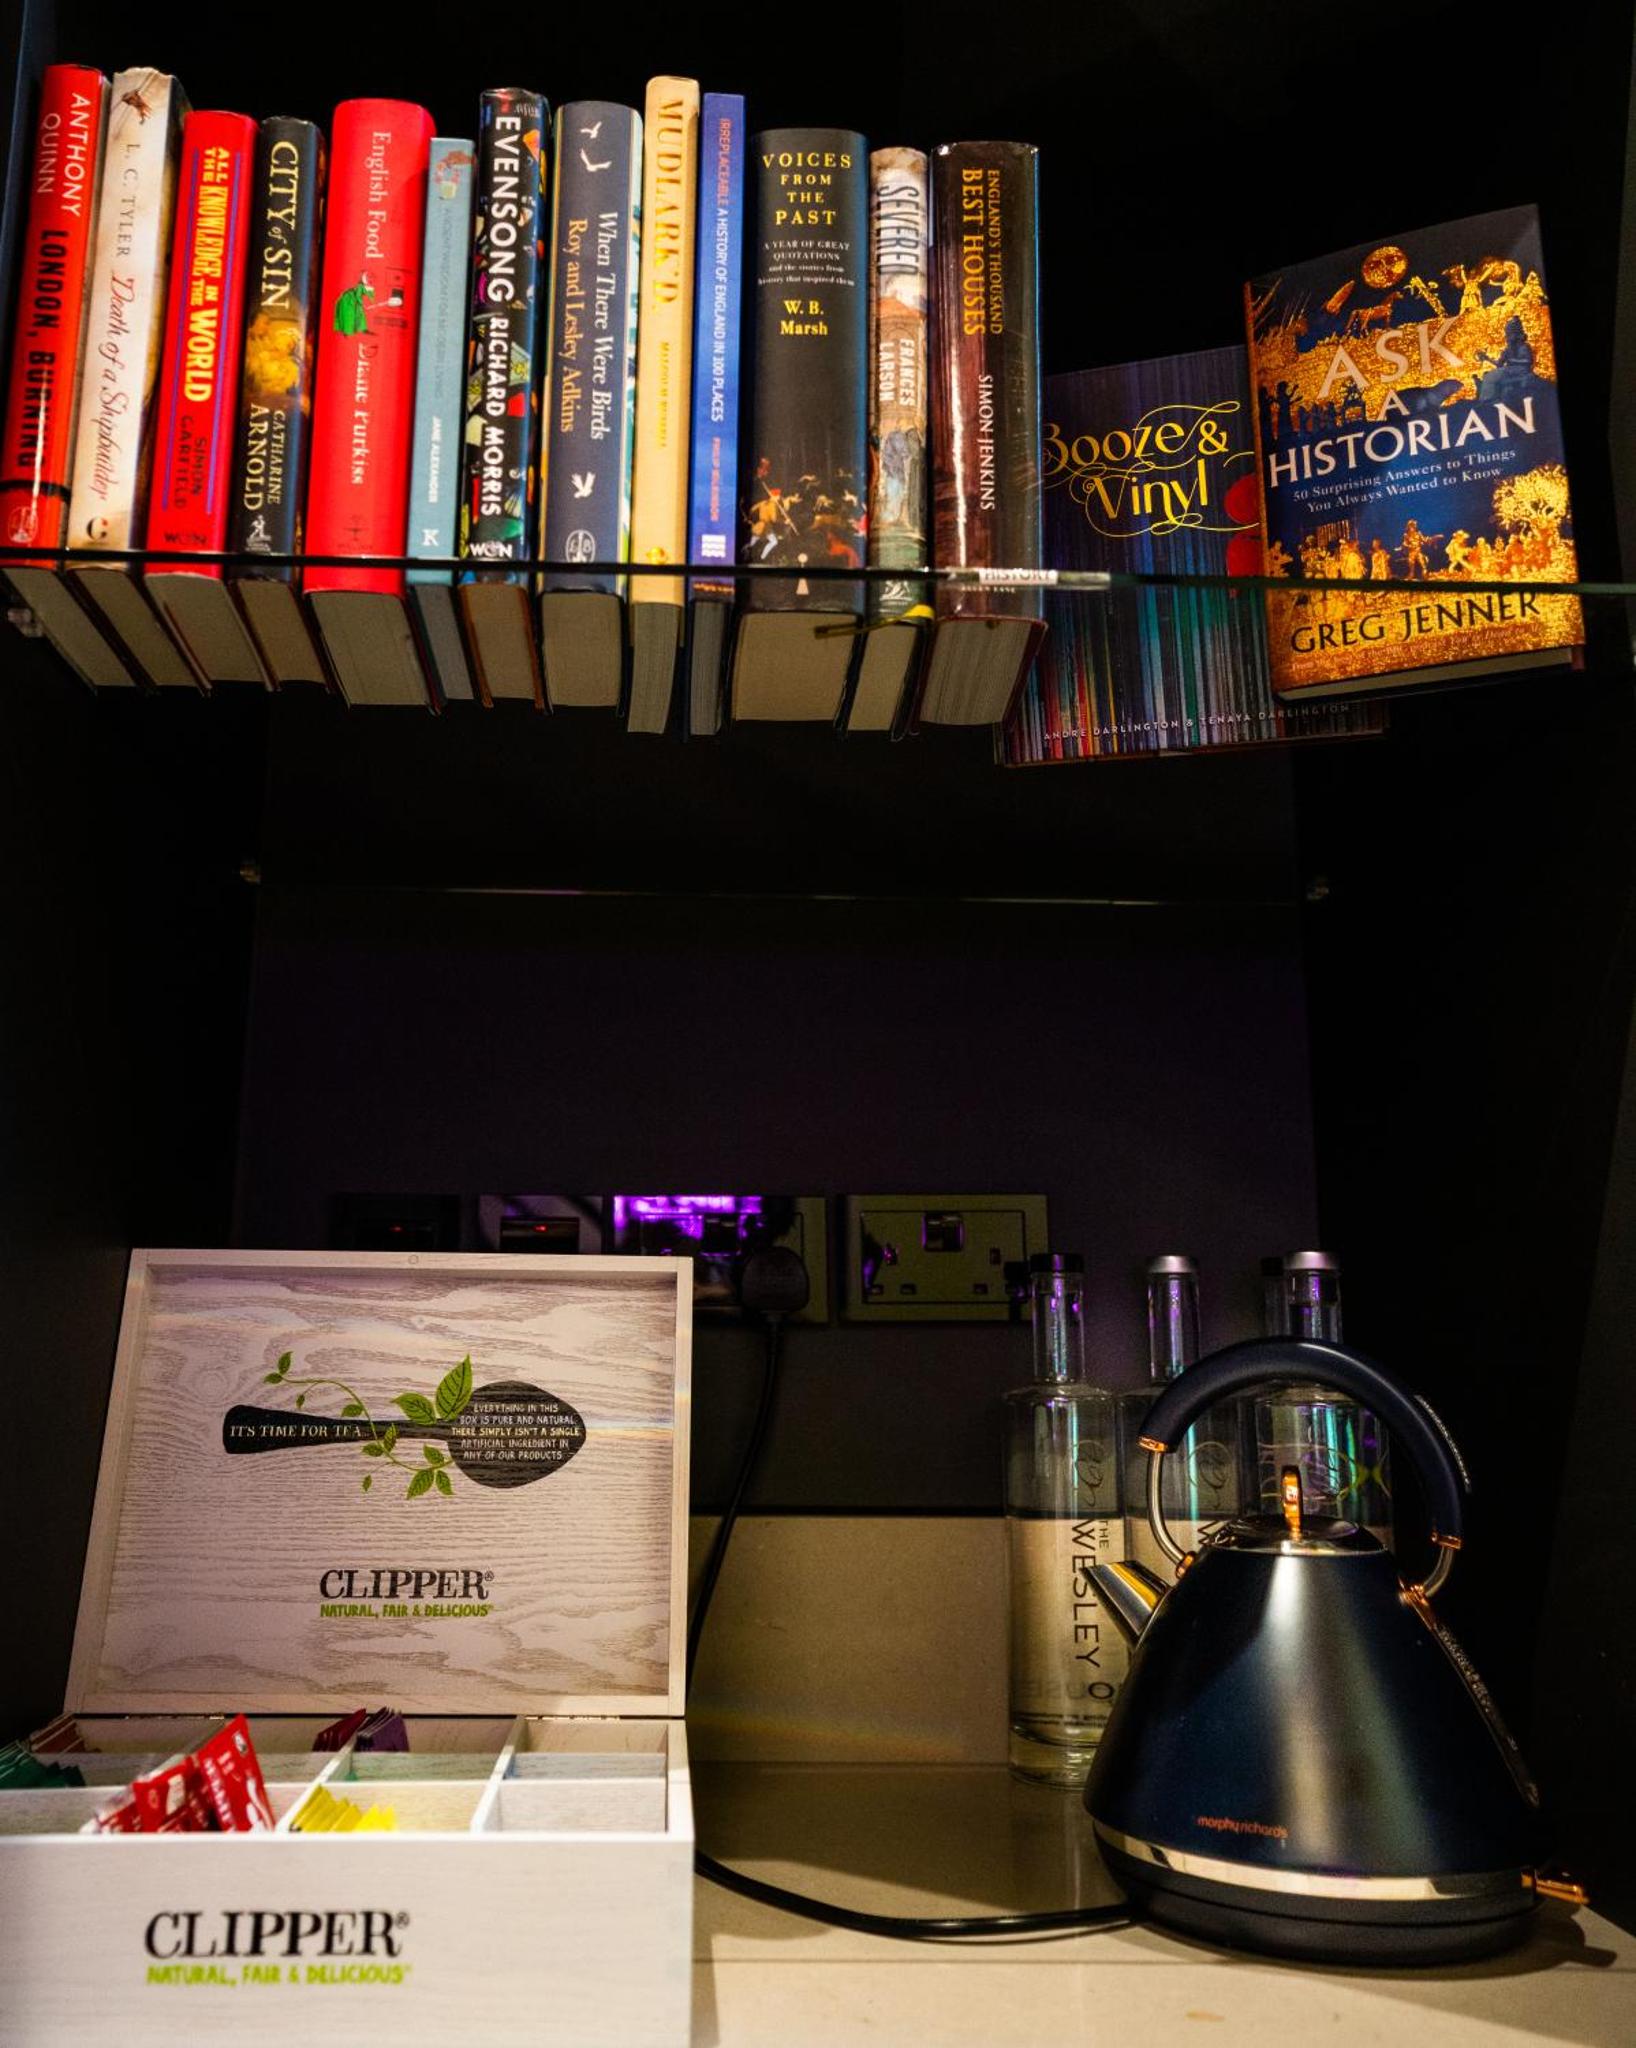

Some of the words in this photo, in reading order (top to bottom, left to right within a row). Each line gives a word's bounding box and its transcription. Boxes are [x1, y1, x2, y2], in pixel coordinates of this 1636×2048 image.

[37, 113, 61, 193] QUINN
[61, 92, 91, 217] ANTHONY
[122, 168, 139, 187] C.
[124, 143, 141, 159] L.
[203, 146, 217, 183] THE
[217, 147, 230, 183] ALL
[365, 132, 391, 202] English
[718, 118, 731, 206] IRREPLACEABLE
[762, 152, 852, 169] VOICES
[267, 141, 299, 231] CITY
[780, 174, 832, 185] FROM
[787, 192, 824, 203] THE
[962, 168, 984, 223] BEST
[116, 196, 136, 257] TYLER
[192, 185, 228, 278] KNOWLEDGE
[268, 226, 287, 244] of
[365, 210, 387, 259] Food
[487, 116, 521, 302] EVENSONG
[718, 208, 729, 219] A
[775, 210, 836, 225] PAST
[876, 185, 919, 275] SEVERED
[987, 170, 1000, 250] ENGLAND'S
[563, 219, 588, 255] Roy
[597, 212, 618, 266] When
[715, 220, 729, 264] HISTORY
[772, 240, 798, 249] YEAR
[801, 240, 815, 249] OF
[817, 240, 850, 251] GREAT
[773, 251, 841, 262] QUOTATIONS
[26, 230, 69, 337] LONDON,
[191, 278, 205, 306] THE
[205, 285, 218, 301] IN
[261, 247, 292, 309] SIN
[566, 261, 585, 297] and
[714, 266, 728, 282] OF
[963, 235, 986, 335] HOUSES
[989, 253, 1003, 334] THOUSAND
[107, 270, 135, 336] Death
[594, 273, 616, 330] There
[713, 283, 727, 340] ENGLAND
[780, 320, 828, 336] Marsh
[784, 300, 804, 315] W.
[808, 300, 824, 315] B.
[98, 341, 125, 369] of
[184, 309, 218, 402] WORLD
[559, 303, 584, 360] Lesley
[713, 342, 725, 355] IN
[1316, 315, 1466, 399] ASK
[102, 368, 117, 383] a
[354, 343, 378, 404] Diane
[485, 317, 510, 417] RICHARD
[593, 336, 613, 384] Were
[712, 356, 725, 376] 100
[879, 342, 895, 402] LARSON
[900, 339, 915, 407] FRANCES
[17, 351, 56, 467] BURNING
[561, 367, 583, 433] Adkins
[591, 388, 612, 440] Birds
[711, 377, 724, 422] PLACES
[978, 374, 994, 433] SIMON
[1379, 389, 1411, 421] A
[88, 385, 129, 501] Shipbuilder
[352, 410, 370, 484] Purkiss
[431, 416, 442, 442] JANE
[1041, 419, 1186, 476] Booze
[1198, 420, 1229, 455] &
[1268, 396, 1537, 488] HISTORIAN
[174, 415, 193, 509] GARFIELD
[193, 436, 206, 496] SIMON
[244, 402, 270, 511] ARNOLD
[267, 410, 287, 505] CATHARINE
[428, 443, 440, 503] ALEXANDER
[481, 426, 504, 516] MORRIS
[977, 438, 995, 511] JENKINS
[1292, 488, 1309, 502] 50
[1311, 475, 1381, 498] Surprising
[1385, 463, 1443, 484] Answers
[1446, 458, 1461, 470] to
[1463, 448, 1517, 468] Things
[1083, 458, 1208, 530] Vinyl
[1306, 500, 1332, 513] You
[1335, 488, 1383, 511] Always
[1385, 477, 1439, 498] Wanted
[1443, 474, 1457, 486] to
[1461, 466, 1502, 483] Know
[1290, 613, 1385, 653] GREG
[1400, 593, 1540, 641] JENNER
[1093, 719, 1178, 736] DARLINGTON
[230, 1425, 255, 1437] IT'S
[260, 1424, 298, 1437] TIME
[301, 1424, 328, 1437] FOR
[452, 1427, 476, 1437] THERE
[480, 1427, 511, 1437] SIMPLY
[514, 1427, 538, 1437] ISN'T
[540, 1427, 547, 1436] A
[550, 1427, 580, 1437] SINGLE
[460, 1415, 478, 1425] BOX
[481, 1415, 490, 1425] IS
[492, 1415, 513, 1425] PURE
[515, 1415, 534, 1425] AND
[474, 1403, 526, 1413] EVERYTHING
[528, 1403, 537, 1413] IN
[540, 1403, 558, 1413] THIS
[461, 1439, 506, 1448] ARTIFICIAL
[508, 1439, 557, 1448] INGREDIENT
[559, 1439, 569, 1449] IN
[463, 1450, 481, 1460] ANY
[484, 1450, 495, 1460] OF
[498, 1450, 516, 1460] OUR
[518, 1450, 562, 1460] PRODUCTS
[1098, 1520, 1109, 1549] THE
[320, 1604, 378, 1618] NATURAL,
[382, 1604, 408, 1617] FAIR
[412, 1604, 420, 1617] &
[1072, 1519, 1100, 1668] WESLEY
[147, 1965, 237, 1987] NATURAL,
[242, 1965, 280, 1985] FAIR
[287, 1965, 299, 1984] &
